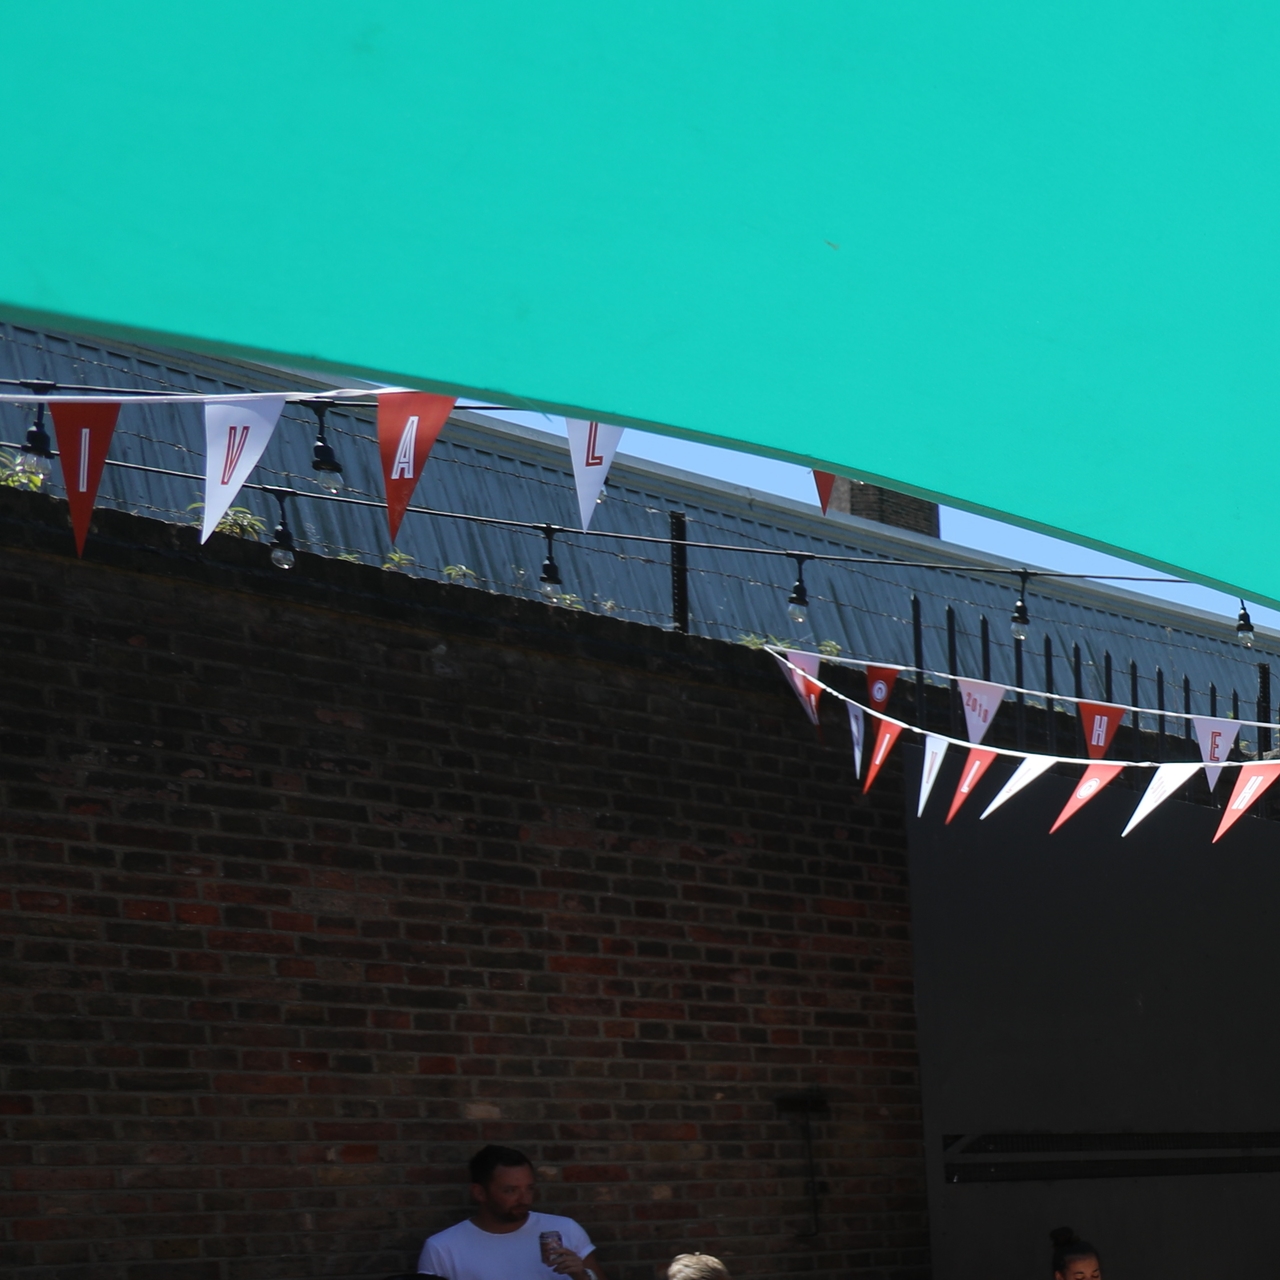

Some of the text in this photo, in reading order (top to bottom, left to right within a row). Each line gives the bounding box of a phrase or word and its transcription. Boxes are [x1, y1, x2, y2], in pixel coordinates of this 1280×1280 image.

[220, 426, 250, 486] V
[391, 416, 419, 479] A
[1091, 715, 1108, 746] H
[1209, 731, 1222, 762] E
